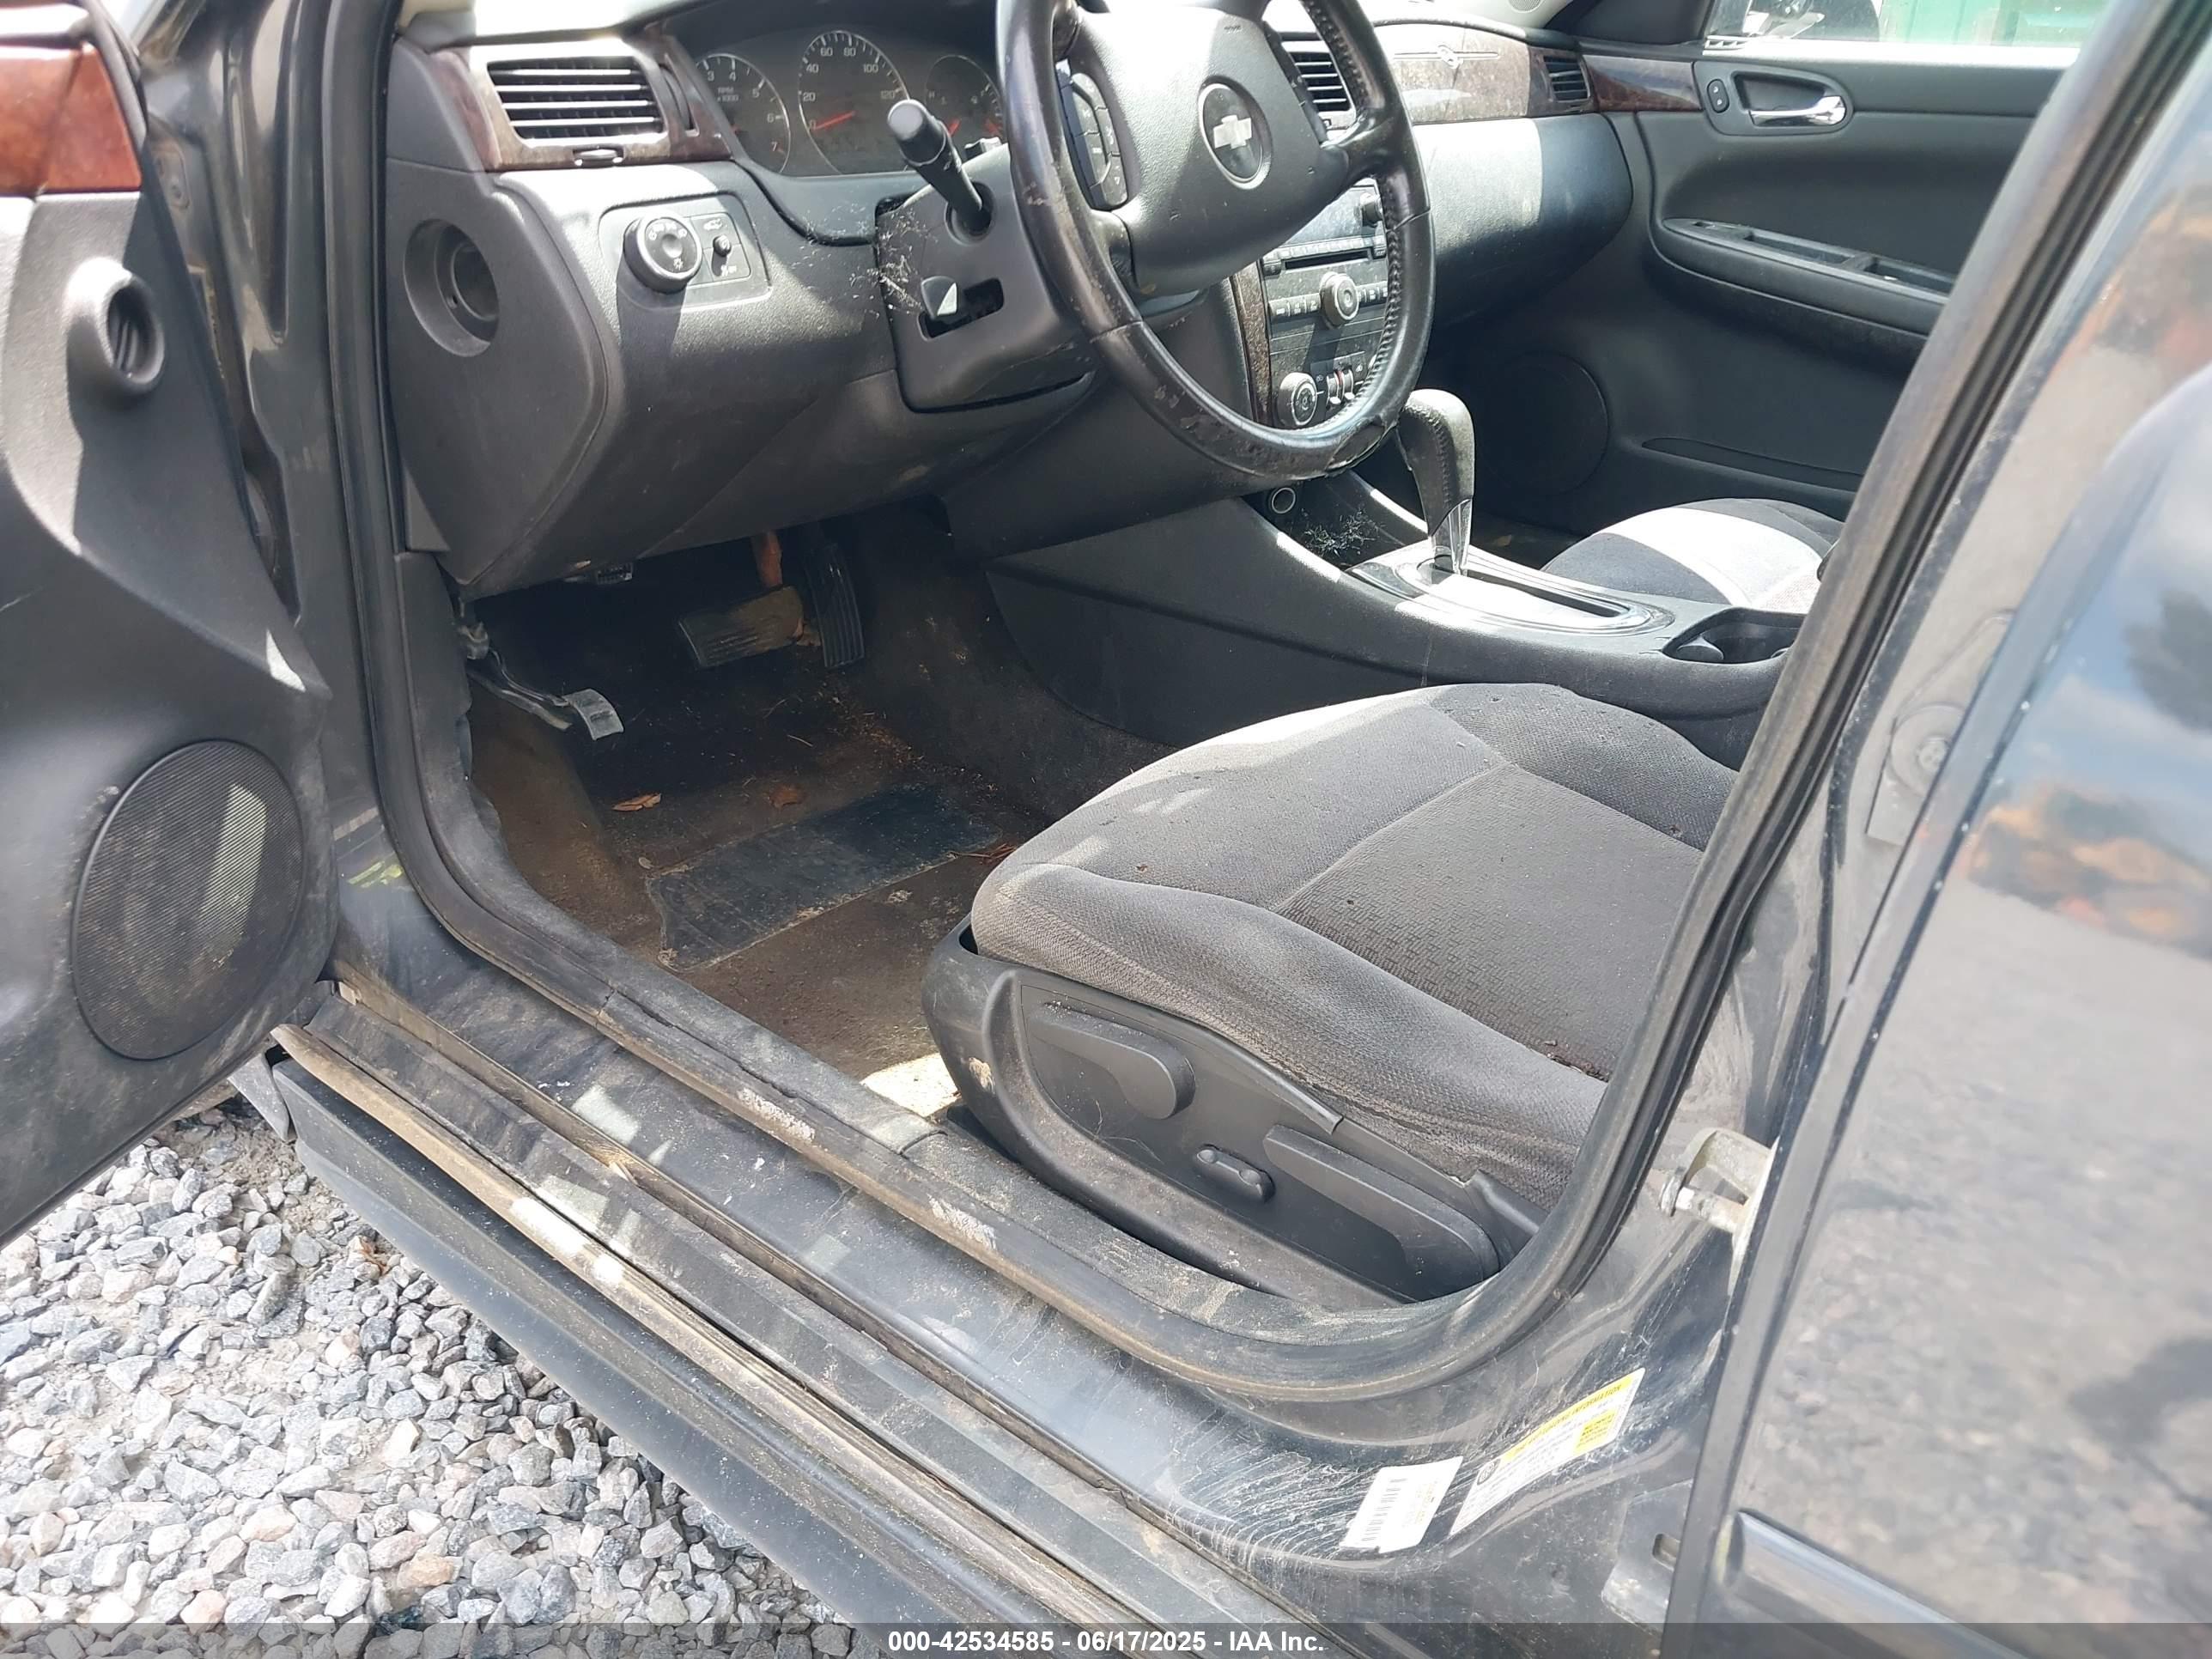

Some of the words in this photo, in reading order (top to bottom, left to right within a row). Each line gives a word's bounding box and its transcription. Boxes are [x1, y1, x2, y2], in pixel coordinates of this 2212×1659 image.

[820, 47, 833, 57] 60
[843, 47, 856, 57] 80
[806, 64, 819, 74] 40
[863, 64, 878, 74] 100
[707, 70, 714, 81] 3
[729, 71, 736, 82] 4
[752, 88, 759, 98] 5
[803, 92, 816, 101] 20
[767, 112, 774, 123] 6
[771, 141, 777, 151] 7
